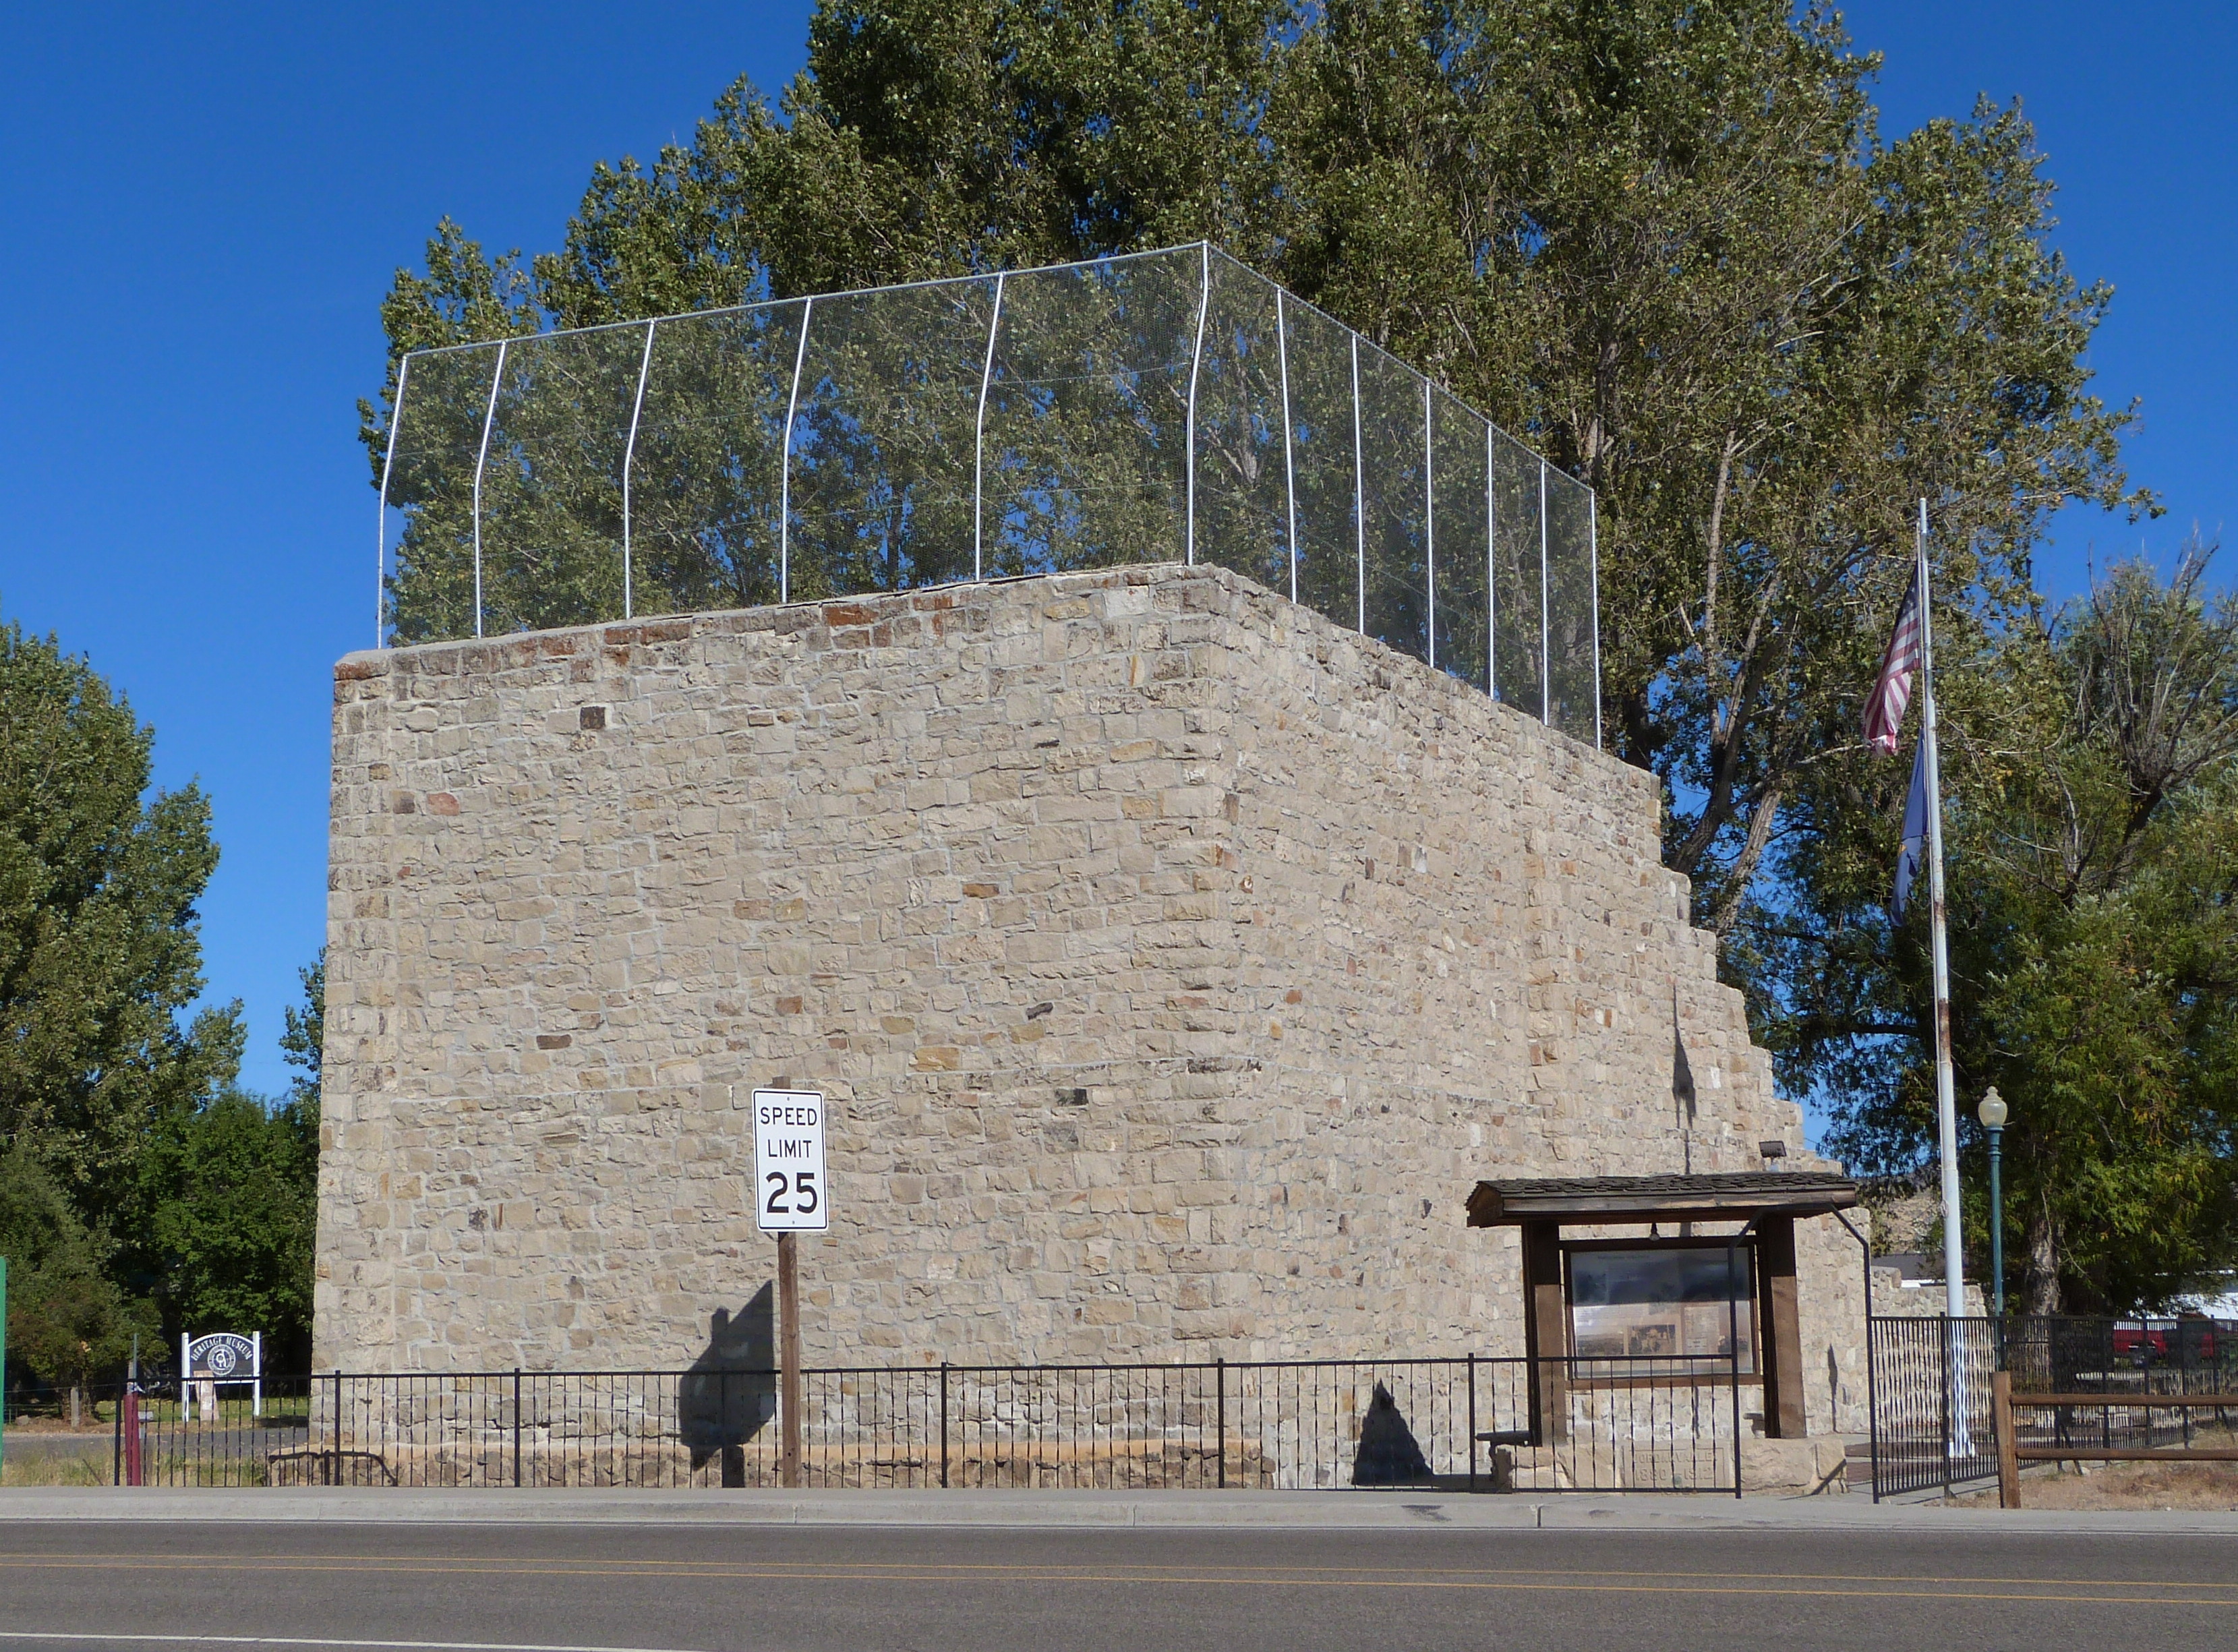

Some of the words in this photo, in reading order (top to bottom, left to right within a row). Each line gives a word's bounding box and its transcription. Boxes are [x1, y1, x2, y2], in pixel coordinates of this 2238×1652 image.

[760, 1107, 817, 1126] SPEED
[767, 1139, 812, 1158] LIMIT
[765, 1171, 818, 1214] 25
[191, 1336, 223, 1361] HERITAGE
[226, 1336, 253, 1360] MUSEUM
[1676, 1451, 1718, 1463] VALLE
